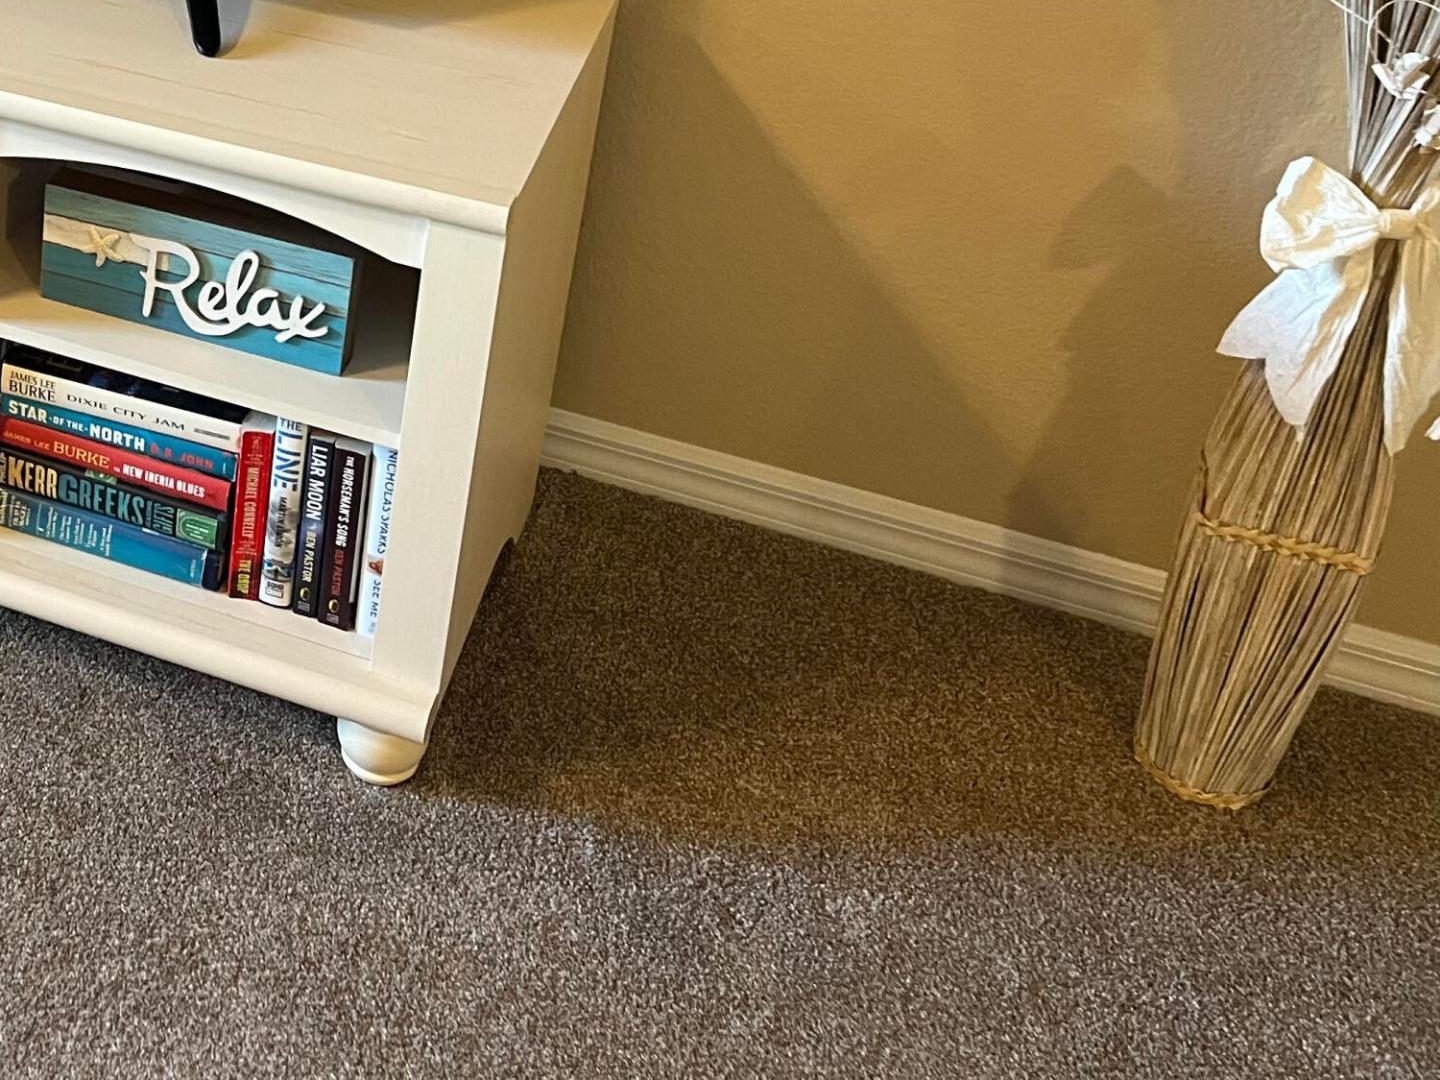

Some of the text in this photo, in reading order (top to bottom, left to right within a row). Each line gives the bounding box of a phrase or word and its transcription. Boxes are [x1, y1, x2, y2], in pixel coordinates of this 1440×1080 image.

[129, 232, 329, 343] Relax
[9, 379, 57, 402] BURKE
[10, 370, 56, 390] JAMES LEE
[8, 400, 48, 424] STAR
[89, 423, 145, 452] NORTH
[66, 394, 185, 431] DIXIE CITY JAM
[280, 417, 302, 432] THE
[3, 430, 110, 469] JAMES LEE BURKE
[180, 453, 215, 470] JOHN
[273, 430, 303, 492] LINE
[7, 455, 58, 499] KERR
[59, 473, 145, 526] GREEKS
[122, 464, 205, 498] NEW IBERIA BLUES
[305, 445, 328, 521] LIAR MOON
[381, 449, 399, 512] NICHOLAS
[241, 466, 260, 538] MICHAEL CONNELLY
[335, 523, 349, 548] SONG
[302, 530, 317, 583] BEN PASTOR
[373, 579, 382, 599] SEE
[370, 601, 380, 618] ME
